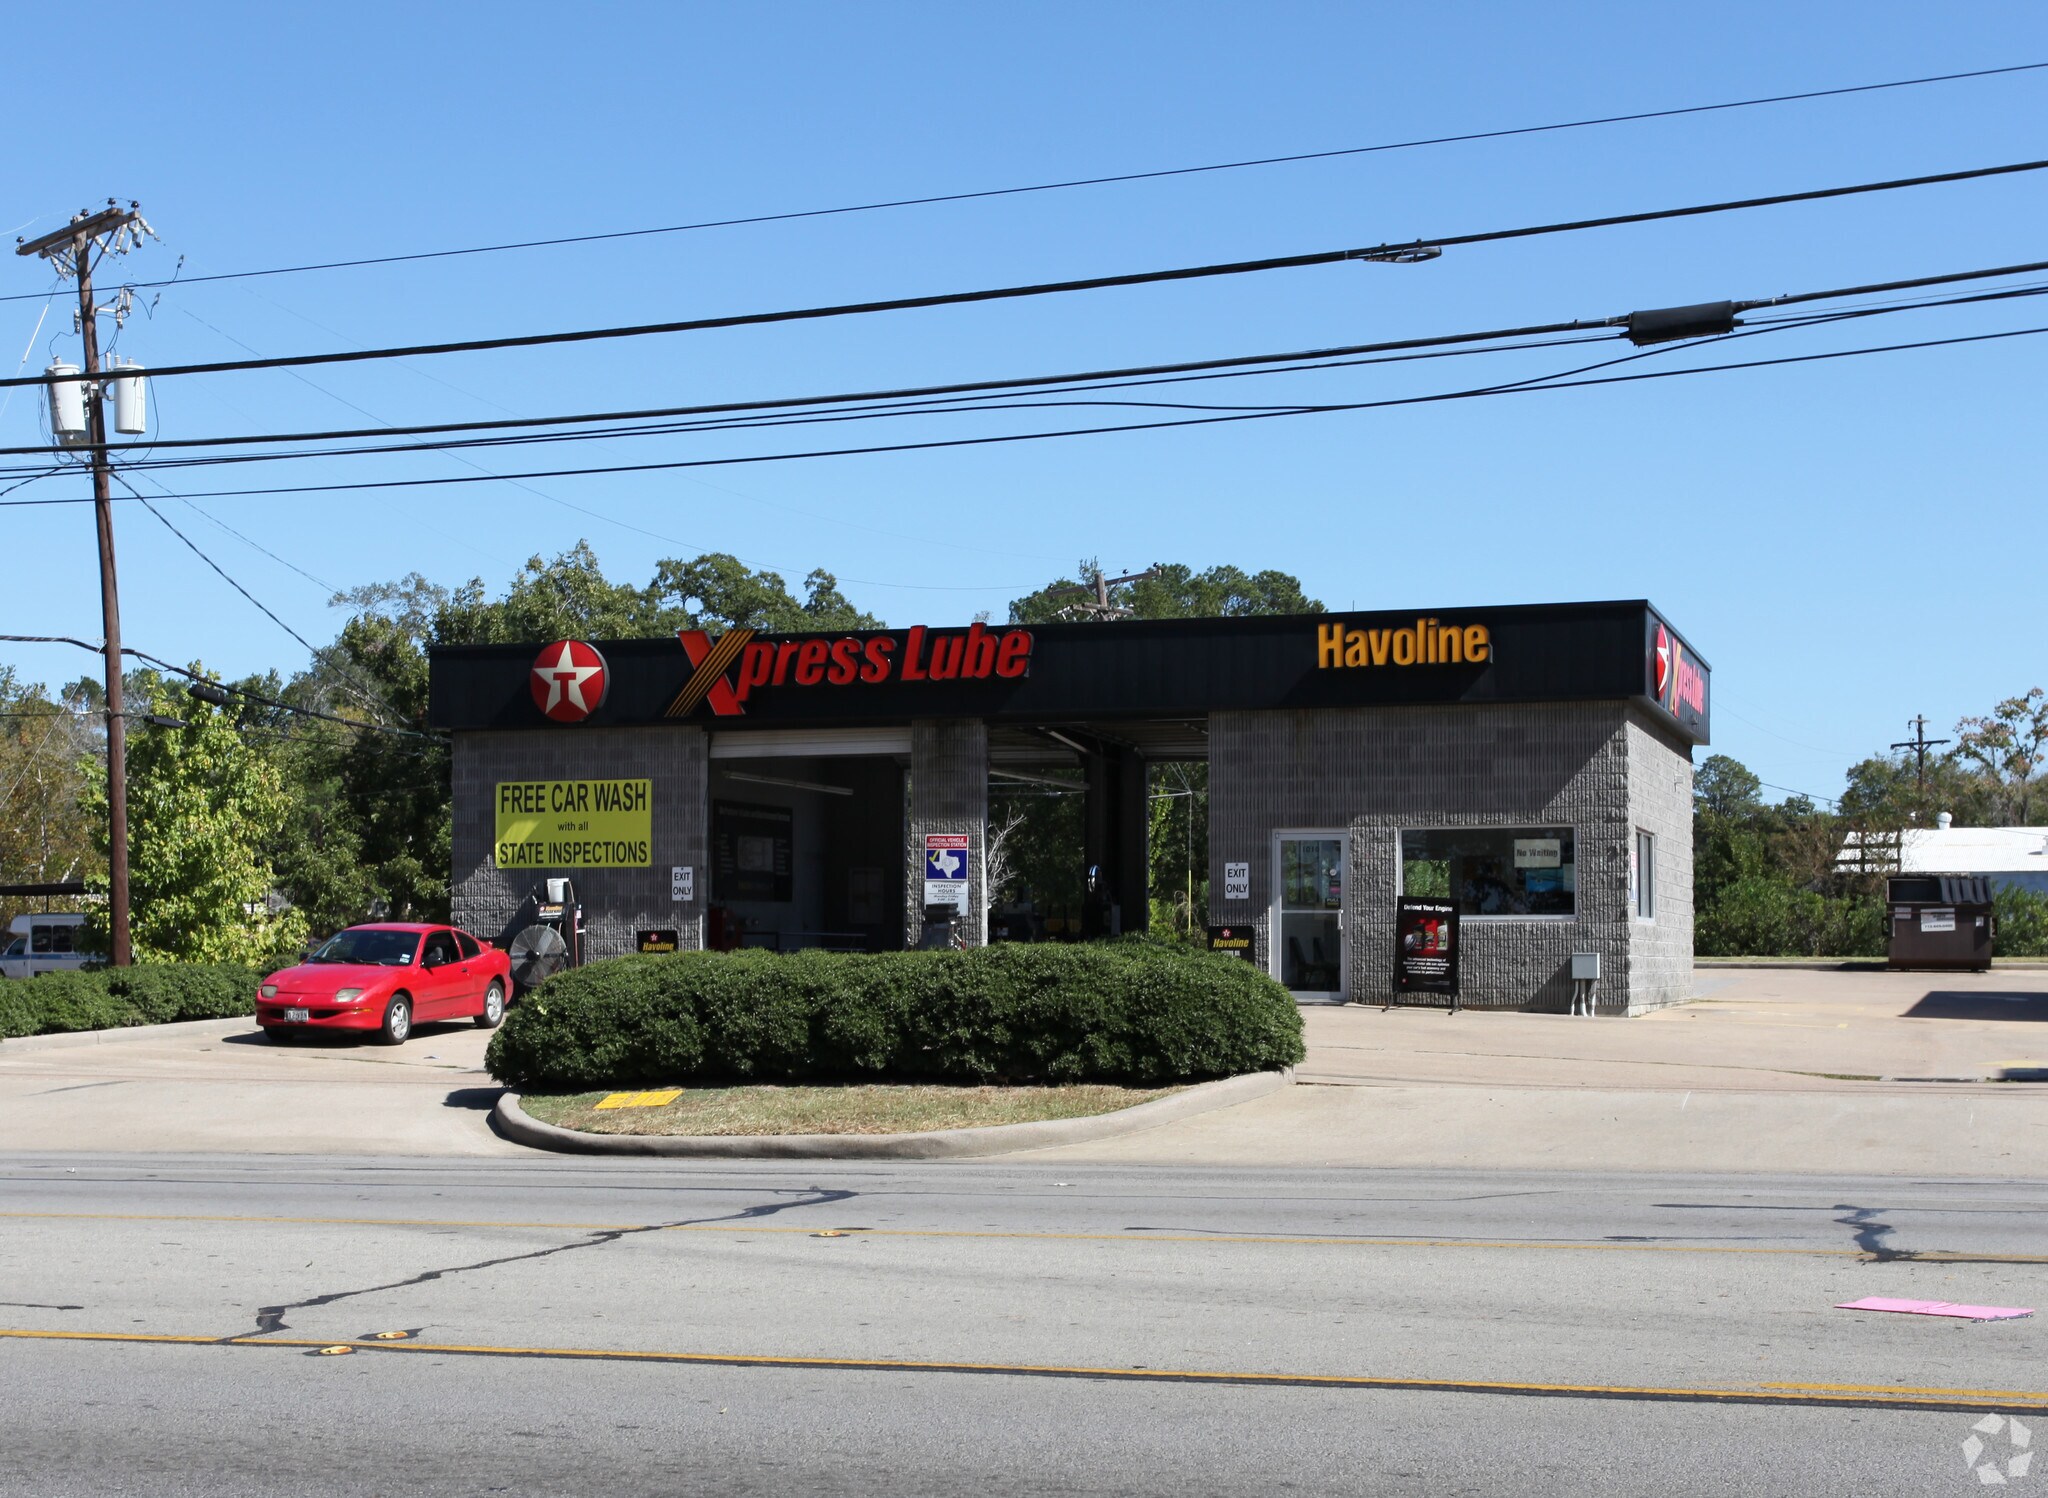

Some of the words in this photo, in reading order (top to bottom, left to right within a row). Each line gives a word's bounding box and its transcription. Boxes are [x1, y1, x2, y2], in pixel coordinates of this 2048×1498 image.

[1318, 618, 1493, 668] Havoline
[664, 629, 897, 717] Xpress
[900, 622, 1034, 681] Lube
[501, 784, 546, 813] FREE
[551, 783, 589, 812] CAR
[594, 782, 647, 811] WASH
[557, 821, 576, 831] with
[578, 821, 590, 831] all
[499, 843, 544, 865] STATE
[548, 841, 648, 864] INSPECTIONS
[1516, 849, 1527, 857] No
[1529, 848, 1558, 858] Waiting
[674, 872, 691, 881] EXIT
[1227, 868, 1246, 878] EXIT
[673, 885, 692, 896] ONLY
[1226, 883, 1248, 893] ONLY
[643, 942, 675, 951] Havoline
[1213, 938, 1249, 948] Havoline
